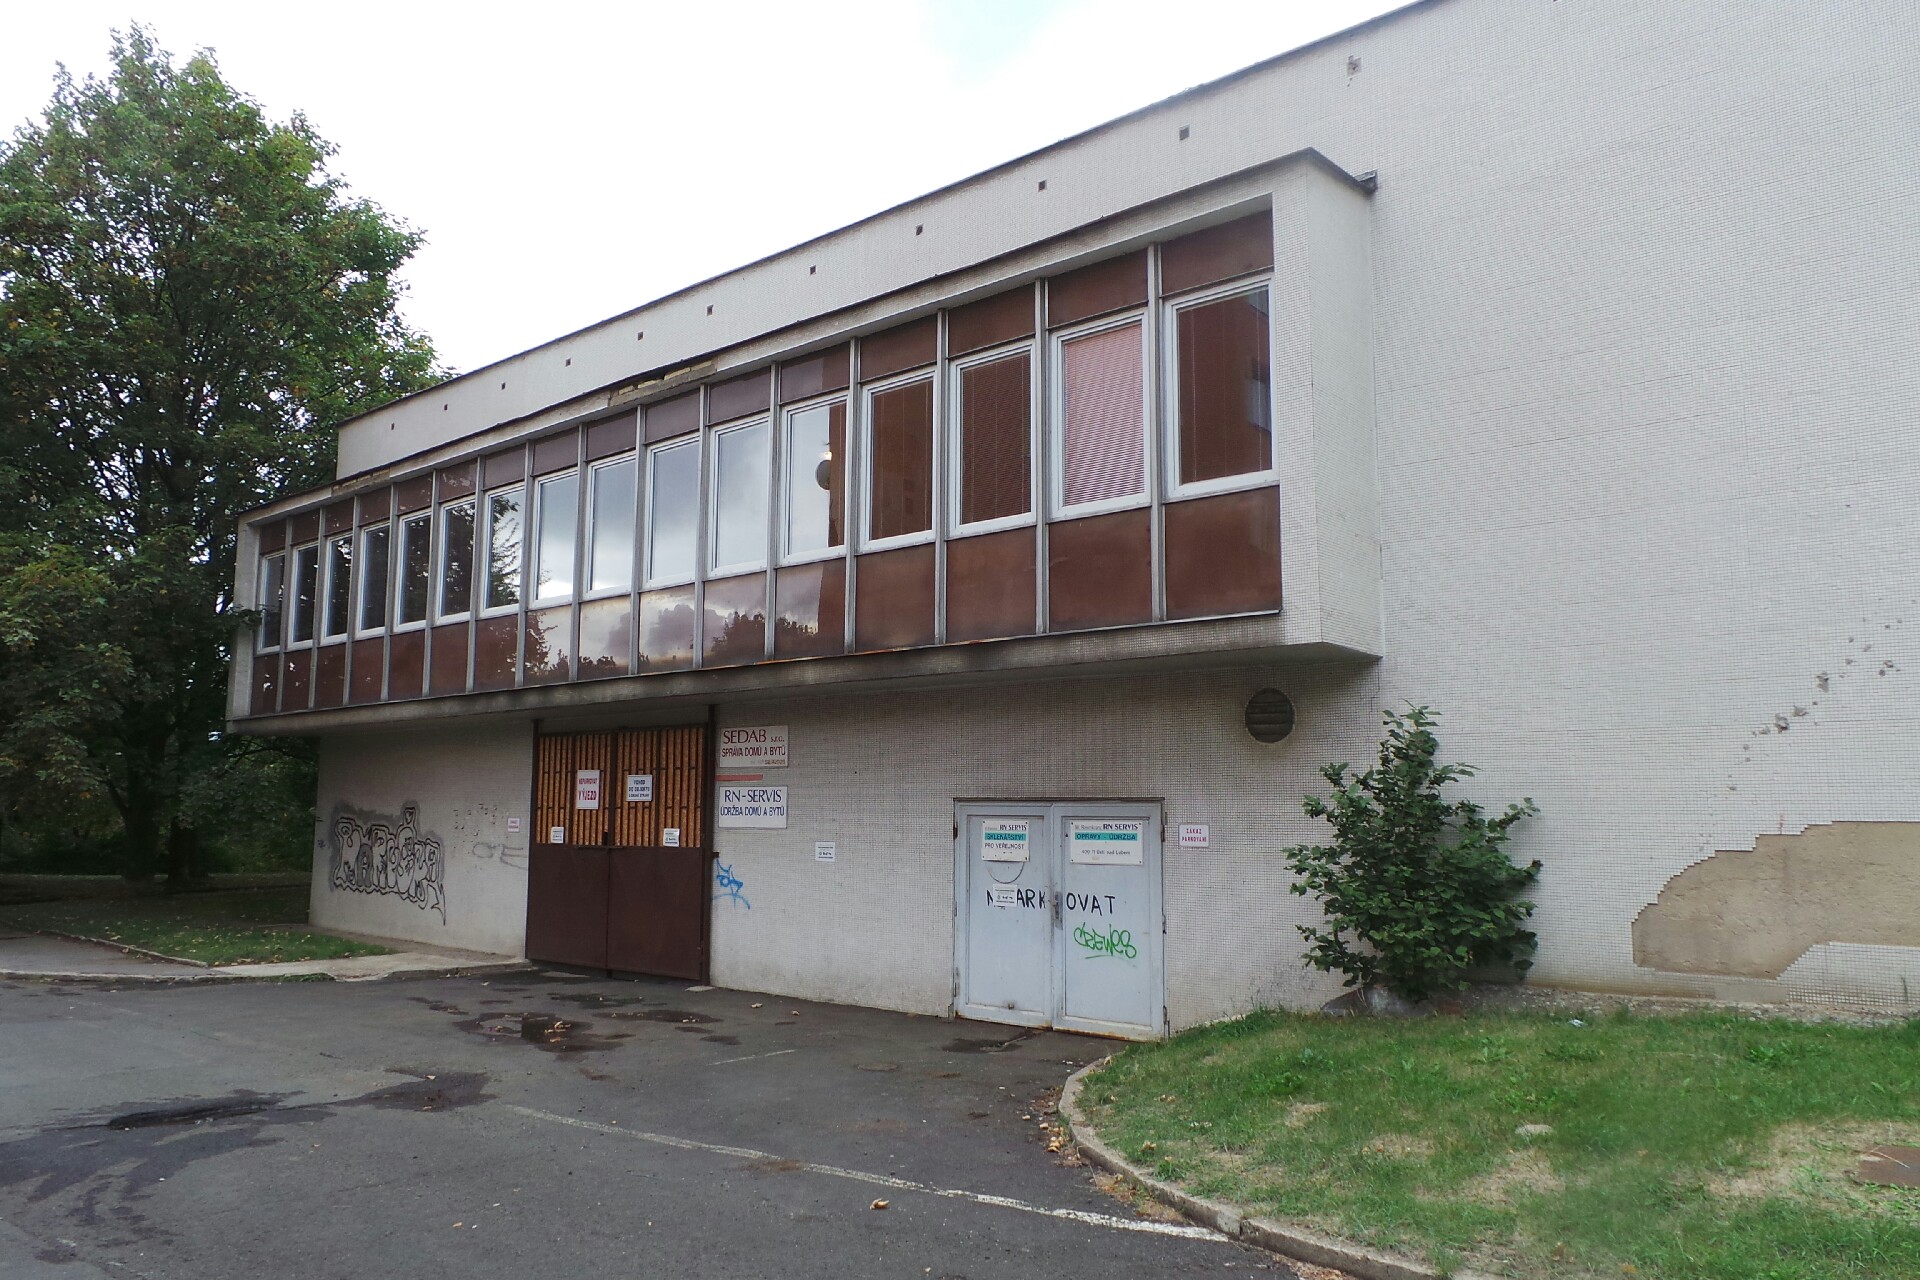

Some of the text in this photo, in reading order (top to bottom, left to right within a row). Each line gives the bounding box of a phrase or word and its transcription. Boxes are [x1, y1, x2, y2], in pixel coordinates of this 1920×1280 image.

[723, 729, 767, 744] SEDAB
[721, 746, 743, 757] SPRÁVA
[764, 747, 768, 756] A
[724, 789, 782, 803] RN-SERVIS
[763, 806, 767, 816] A
[1114, 823, 1139, 831] SERVIS
